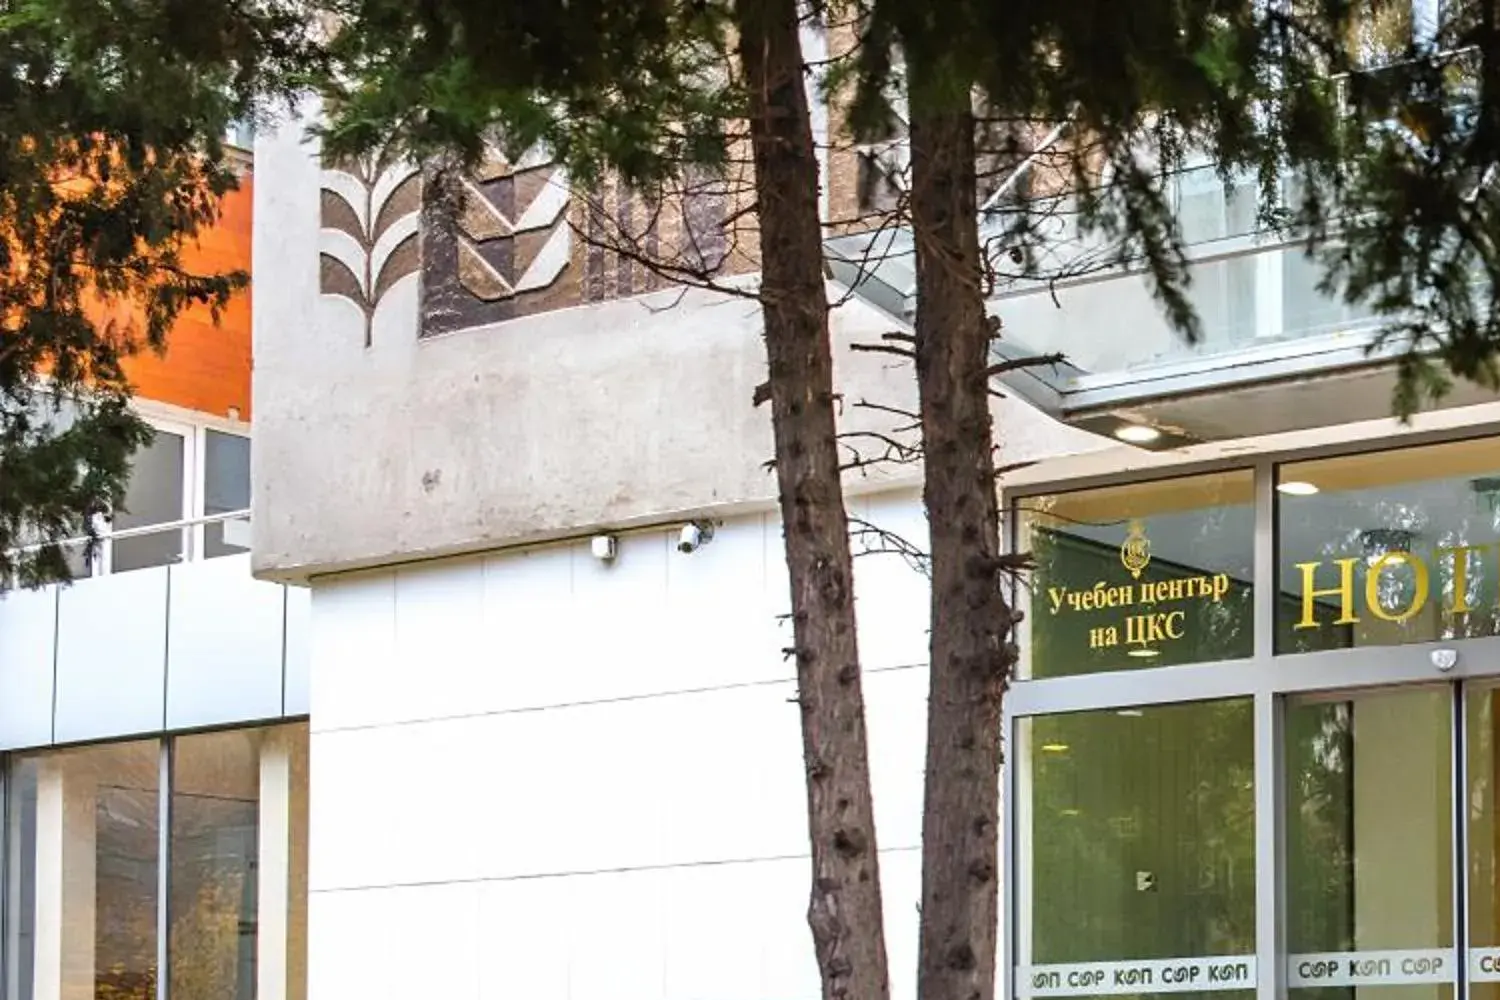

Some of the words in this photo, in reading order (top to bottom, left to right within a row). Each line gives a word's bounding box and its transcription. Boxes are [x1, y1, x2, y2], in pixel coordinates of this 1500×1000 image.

[1047, 582, 1134, 614] Учебен
[1140, 573, 1229, 603] център
[1090, 627, 1118, 648] на
[1126, 611, 1186, 647] ЦКС
